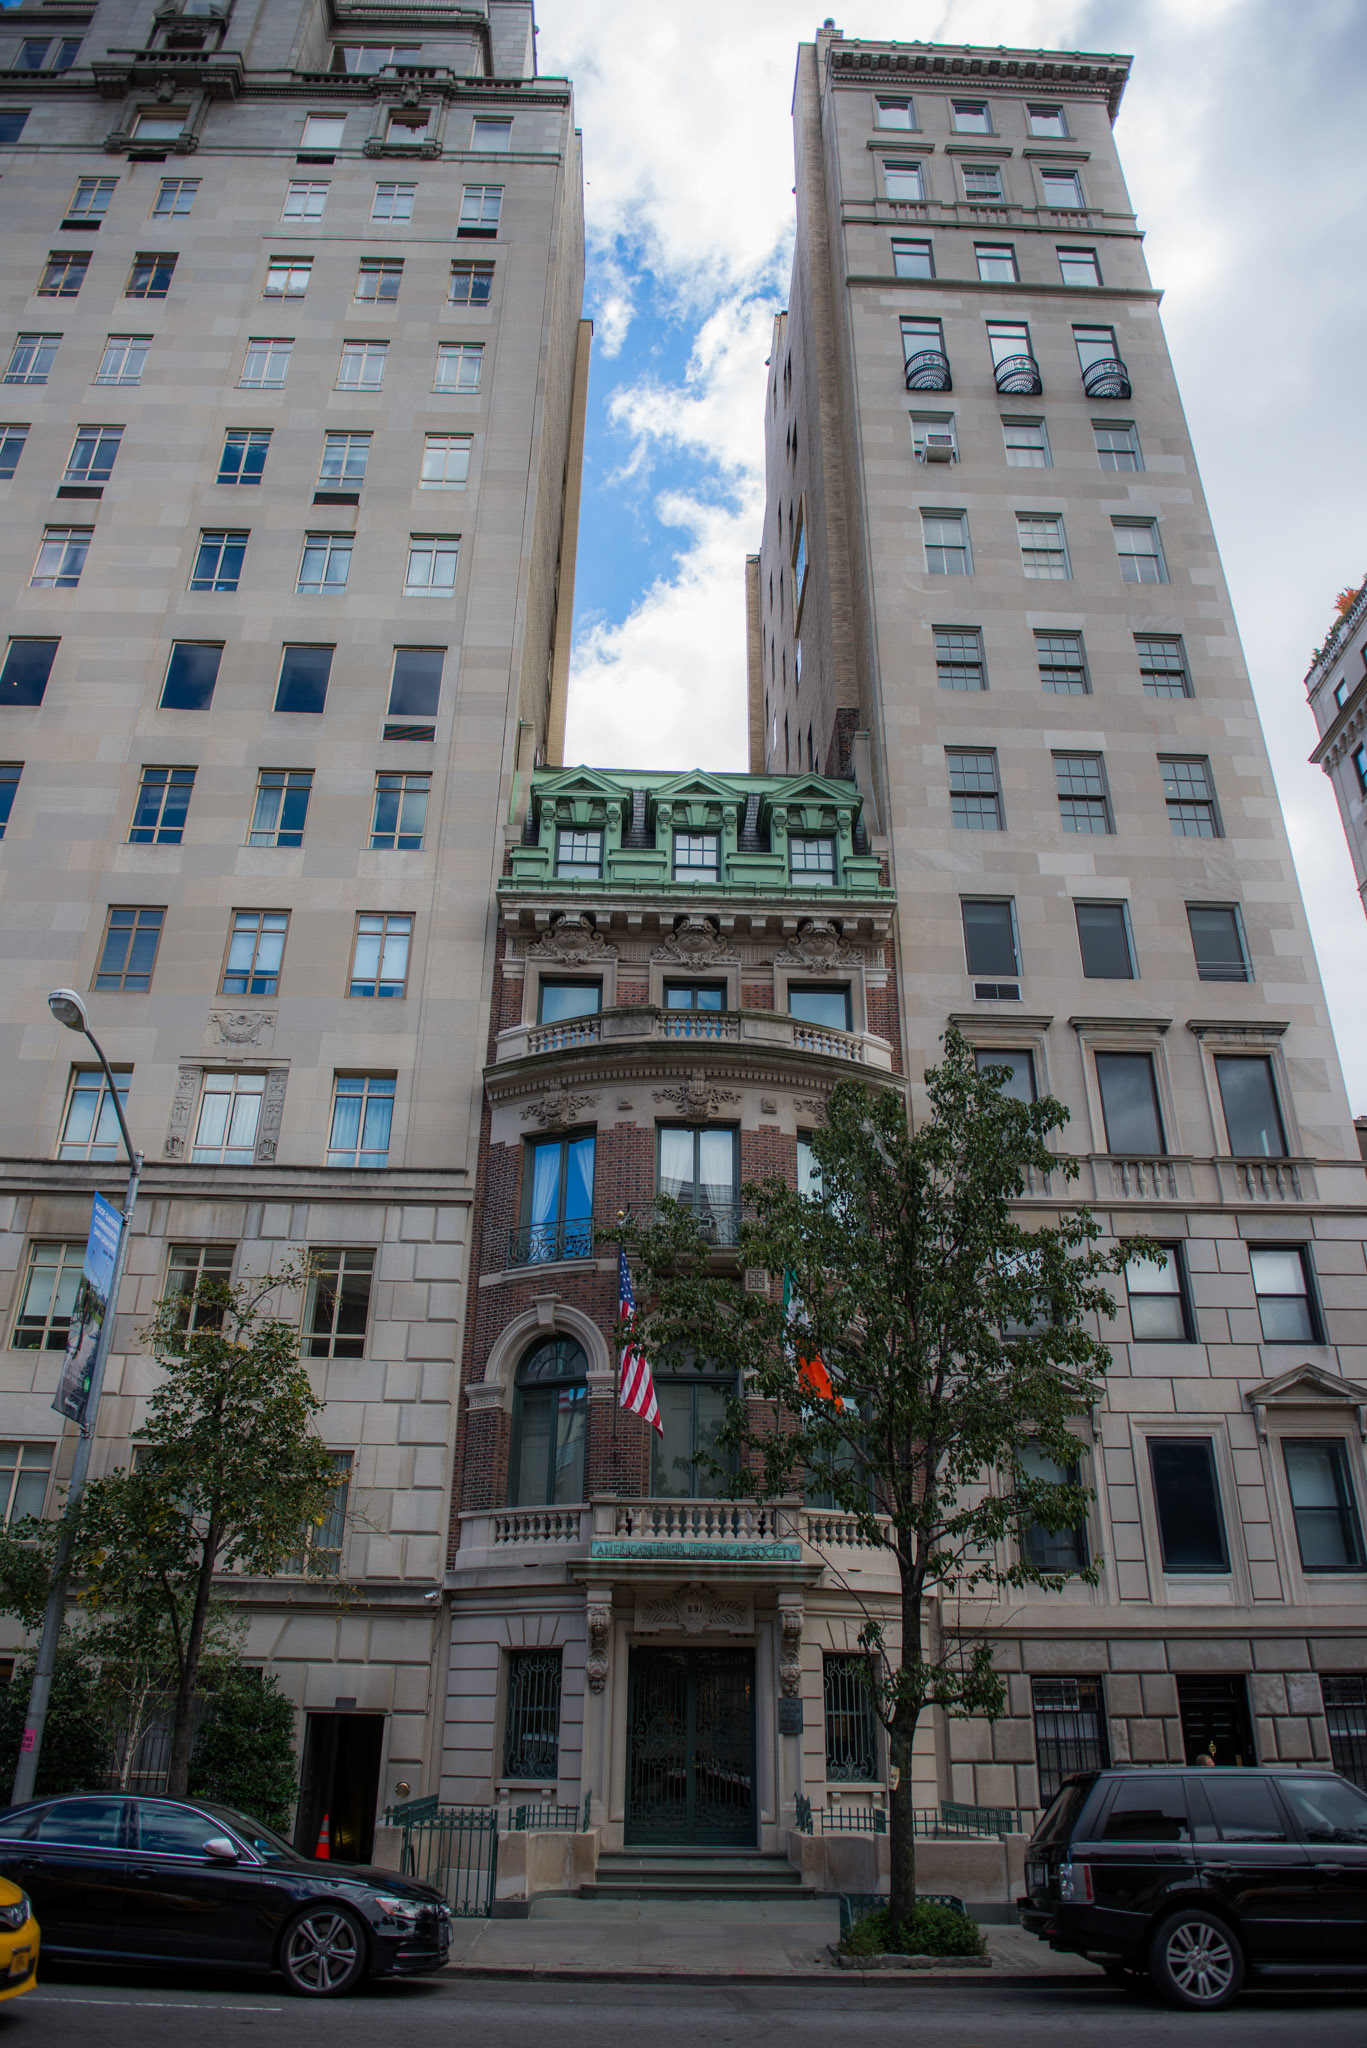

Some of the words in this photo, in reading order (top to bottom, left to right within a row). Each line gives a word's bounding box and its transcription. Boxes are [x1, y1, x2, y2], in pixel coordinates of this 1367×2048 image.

[596, 1543, 653, 1556] AMERICAN
[657, 1544, 684, 1556] IRISH
[689, 1545, 748, 1558] HISTORICAL
[751, 1546, 794, 1559] SOCIETY
[687, 1604, 703, 1613] 991
